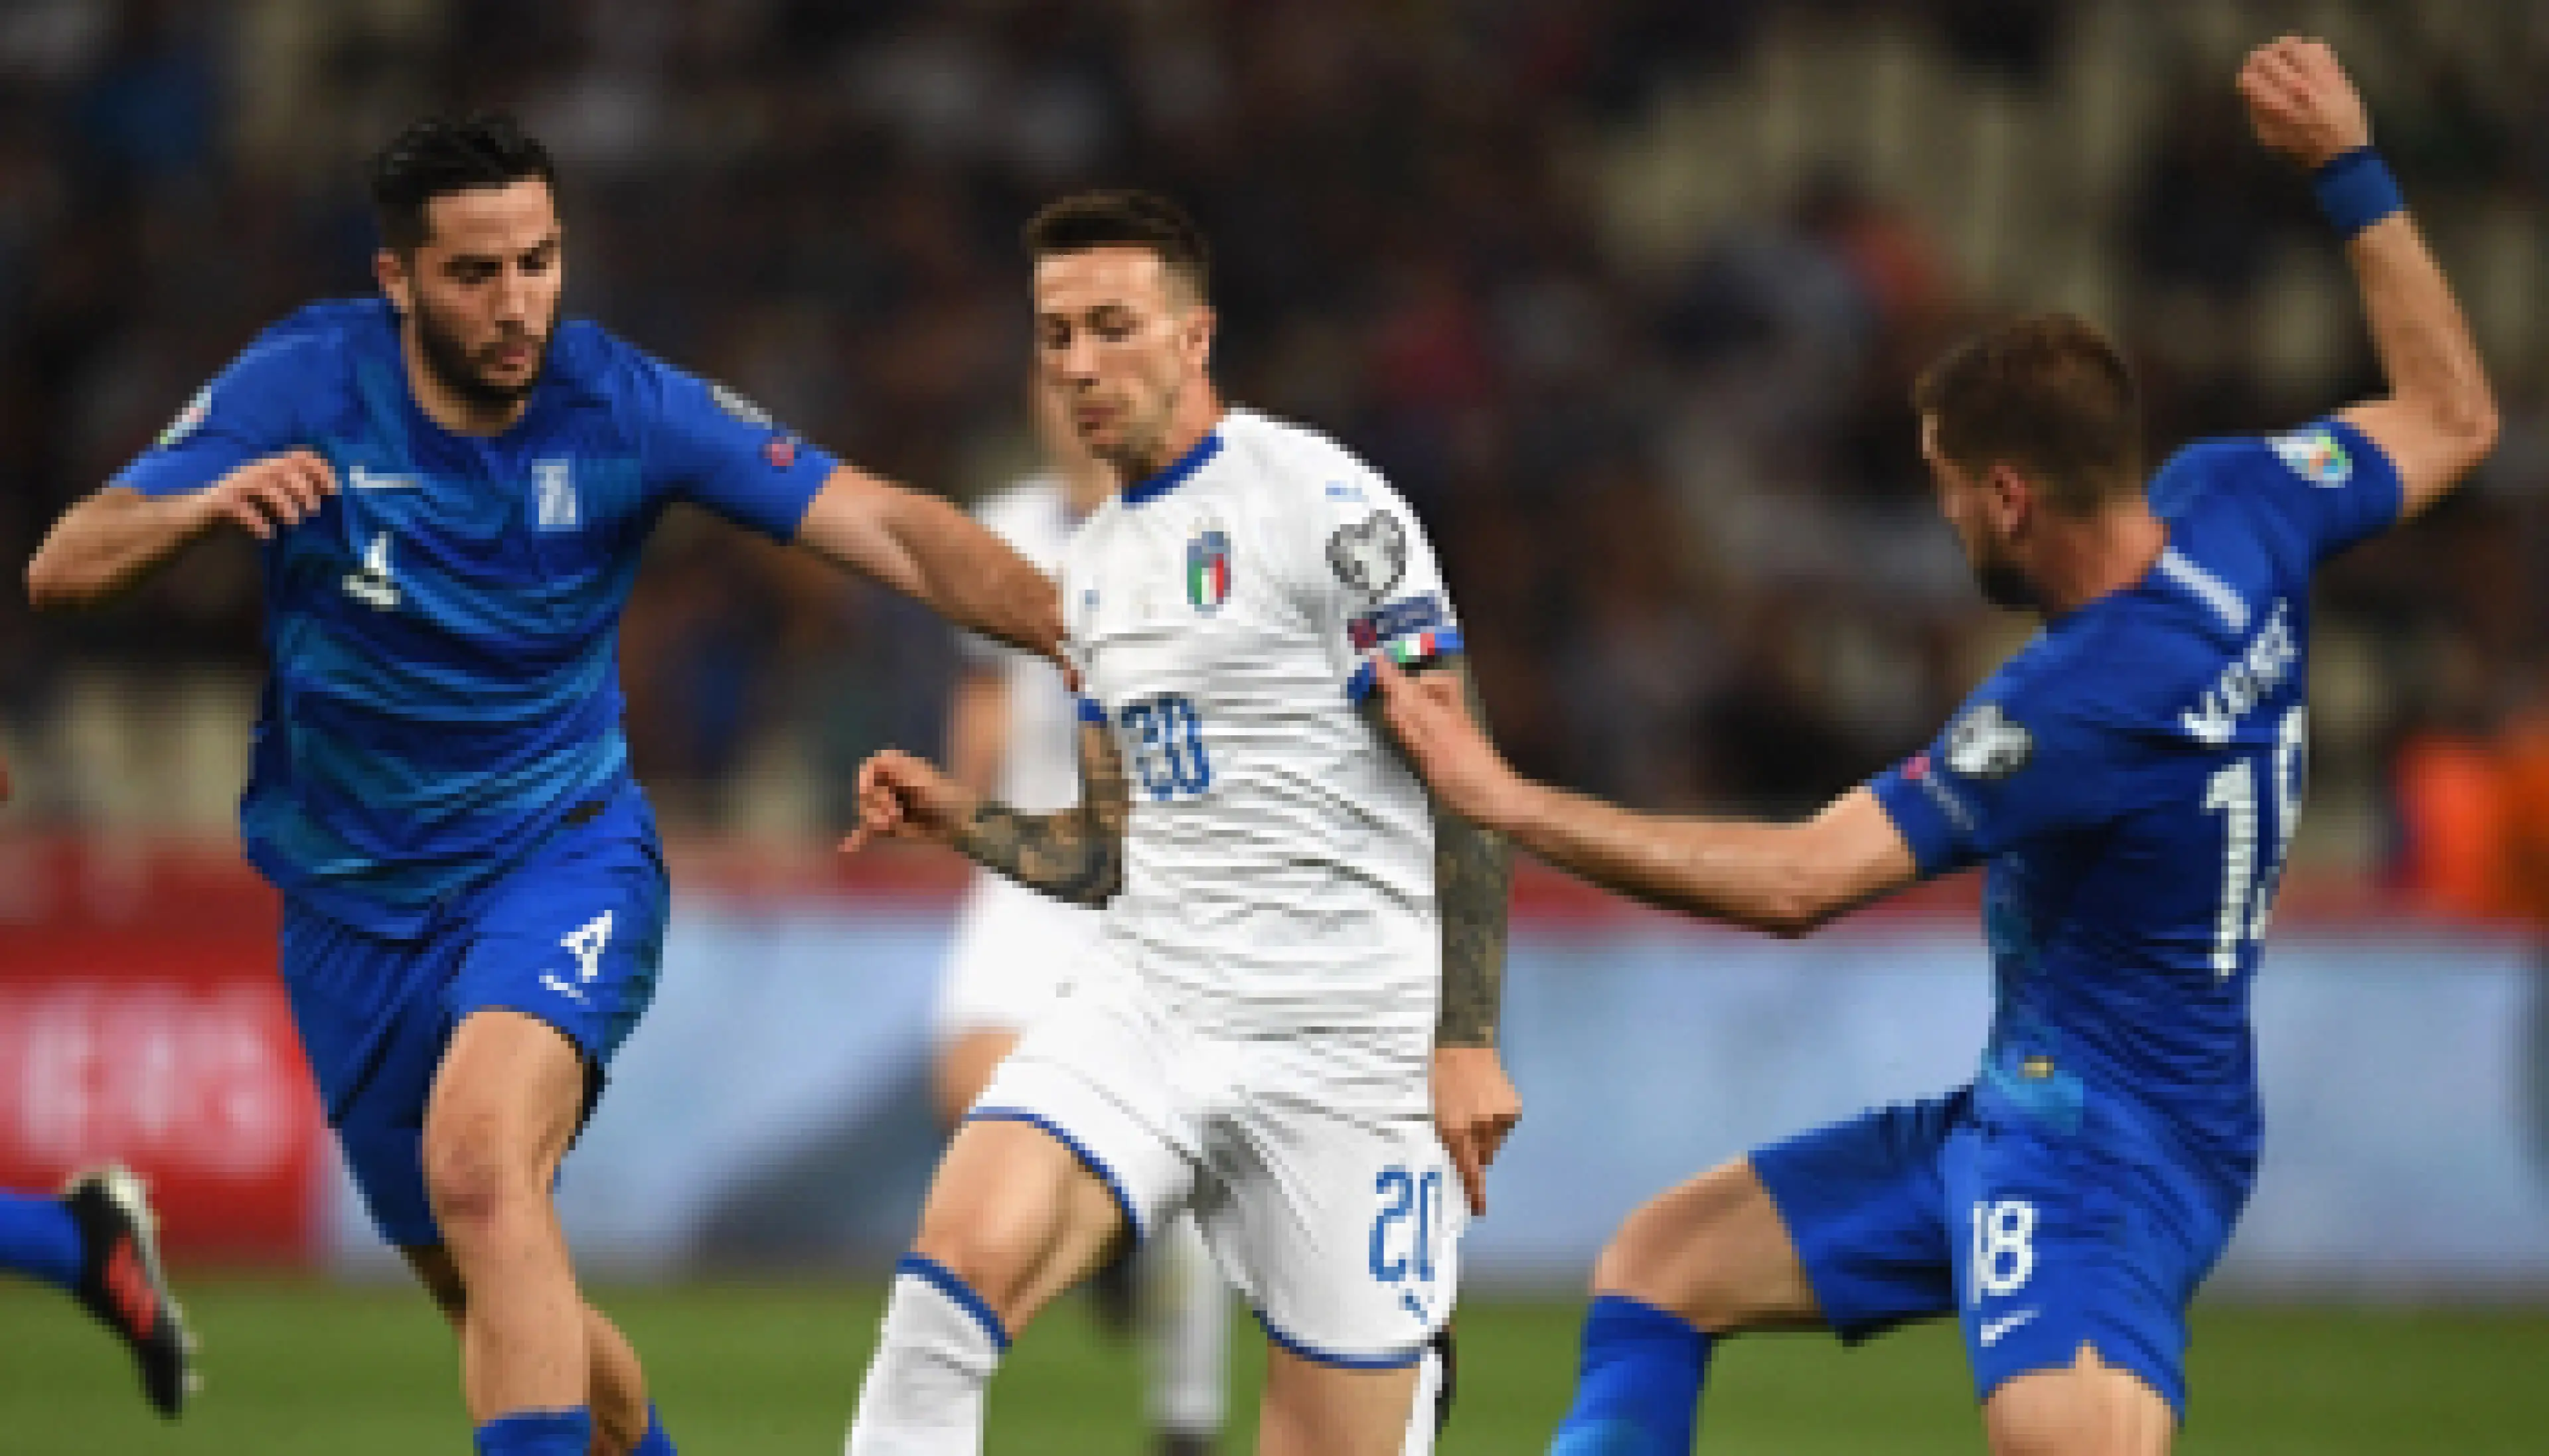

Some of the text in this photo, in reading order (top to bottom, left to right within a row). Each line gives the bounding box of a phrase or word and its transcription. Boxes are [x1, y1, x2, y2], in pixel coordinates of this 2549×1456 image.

[1122, 693, 1211, 800] 20
[560, 909, 613, 983] 4
[1967, 1198, 2038, 1307] 18
